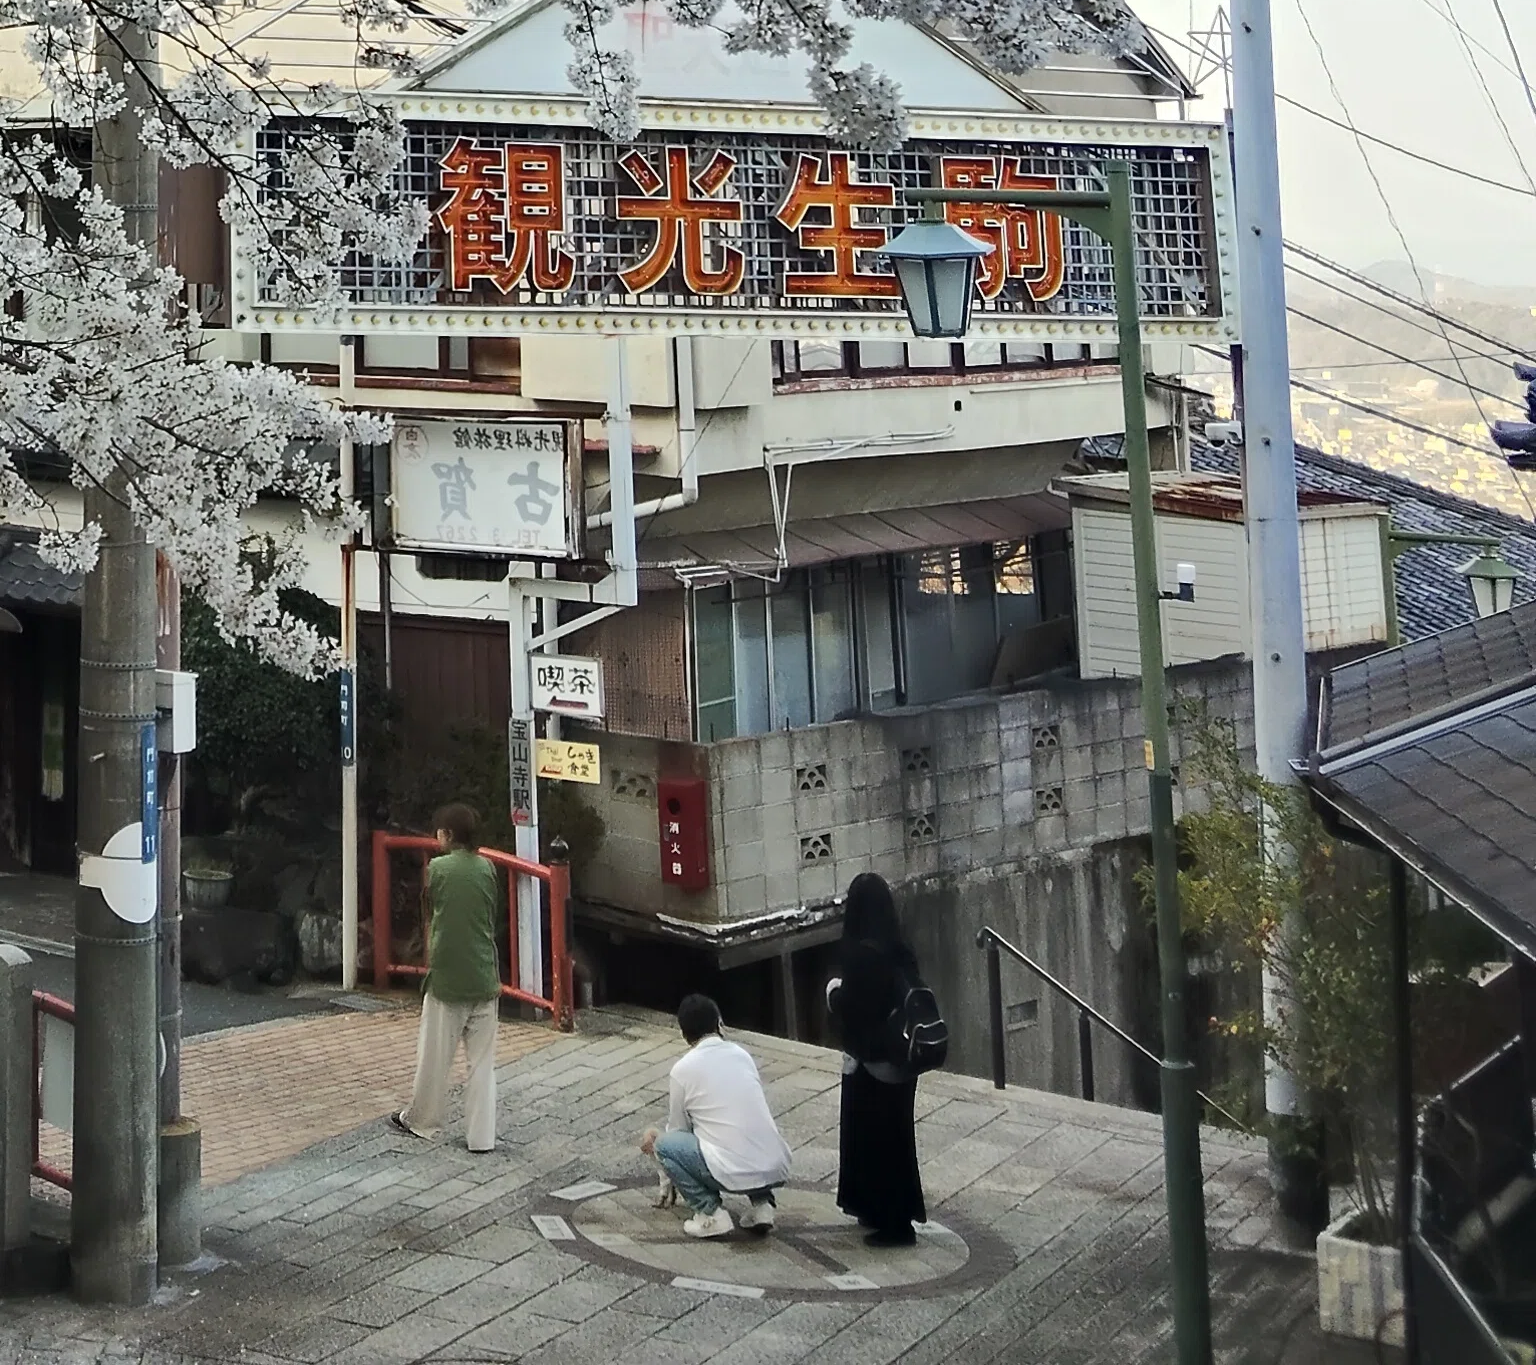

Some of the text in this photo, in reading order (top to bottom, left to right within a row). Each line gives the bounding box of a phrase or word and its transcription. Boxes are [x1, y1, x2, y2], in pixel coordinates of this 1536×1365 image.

[436, 135, 1066, 302] 観光生駒
[537, 665, 596, 695] 喫茶
[511, 720, 531, 811] 宝山寺駅
[145, 835, 155, 853] 11
[669, 821, 682, 875] 消火器
